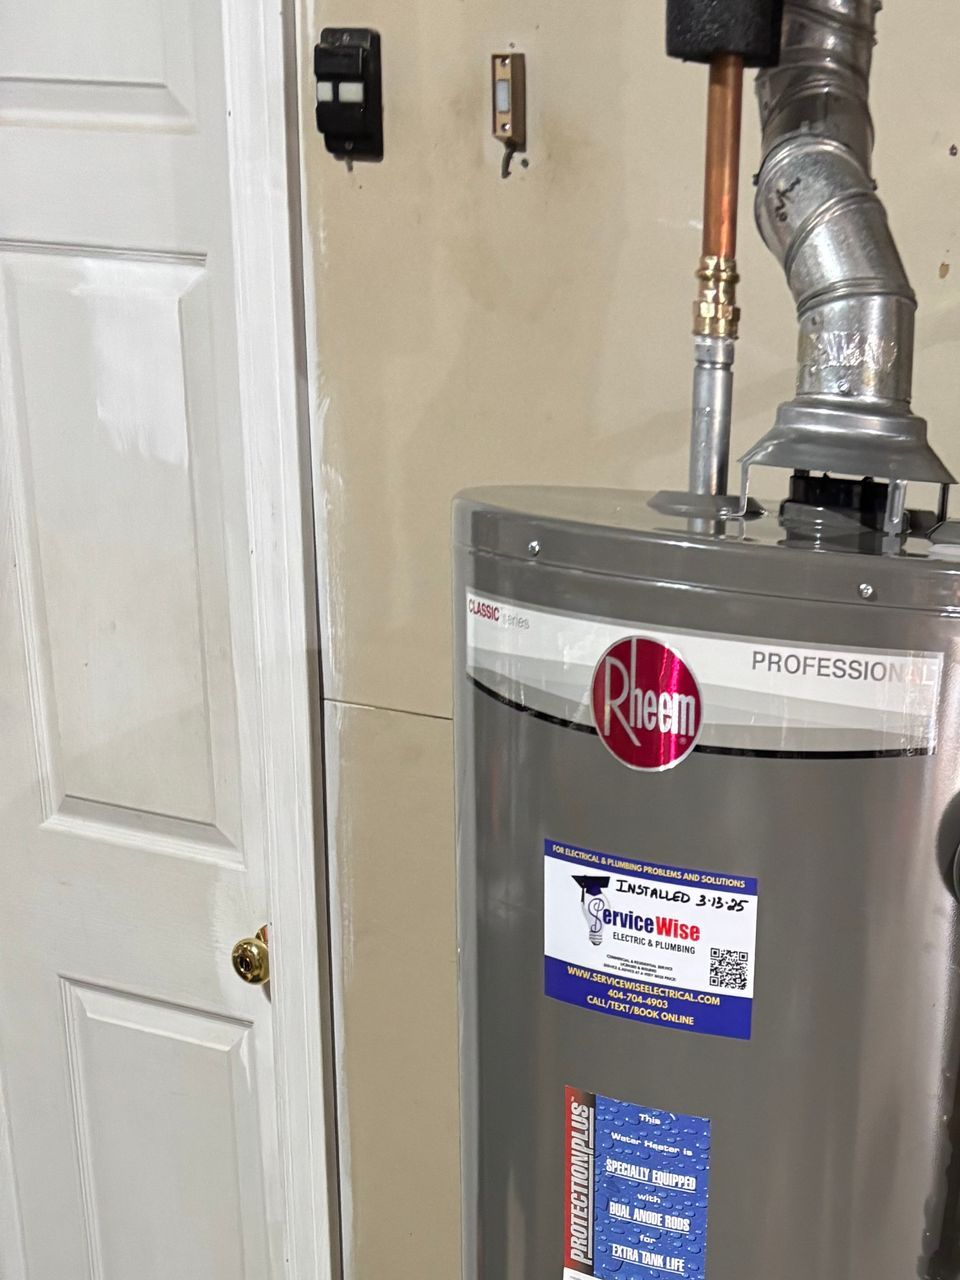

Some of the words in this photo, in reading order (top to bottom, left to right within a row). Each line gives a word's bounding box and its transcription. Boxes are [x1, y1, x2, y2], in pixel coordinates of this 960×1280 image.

[469, 599, 499, 622] CLASSIC
[502, 611, 530, 630] series
[752, 651, 935, 687] PROFESSIONAL
[603, 637, 696, 747] Rheem
[552, 845, 565, 854] FOR
[565, 848, 600, 864] ELECTRICAL
[607, 858, 642, 872] PLUMBING
[643, 865, 682, 879] PROBLEMS
[683, 872, 700, 881] AND
[701, 875, 745, 888] SOLUTIONS
[616, 879, 690, 903] INSTALLED
[613, 932, 647, 947] ELECTRIC
[647, 938, 654, 947] &
[655, 941, 696, 955] PLUMBING
[567, 965, 721, 1006] WWW.SERVICEWISEELECTRICAL.COM
[607, 989, 668, 1009] 404-704-4903
[587, 995, 659, 1019] CALL/TEXT/BOOK
[661, 1012, 694, 1025] ONLINE
[639, 1113, 661, 1125] This
[611, 1132, 641, 1145] Water
[644, 1140, 680, 1153] Heater
[683, 1148, 693, 1156] is
[606, 1158, 649, 1180] SPECIALLY
[652, 1170, 696, 1190] EQUIPPED
[637, 1193, 661, 1203] with
[609, 1201, 631, 1218] DUAL
[633, 1208, 663, 1226] ANODE
[664, 1215, 690, 1231] RODS
[639, 1234, 656, 1243] for
[612, 1243, 639, 1261] EXTRA
[639, 1250, 664, 1267] TANK
[666, 1256, 685, 1271] LIFE
